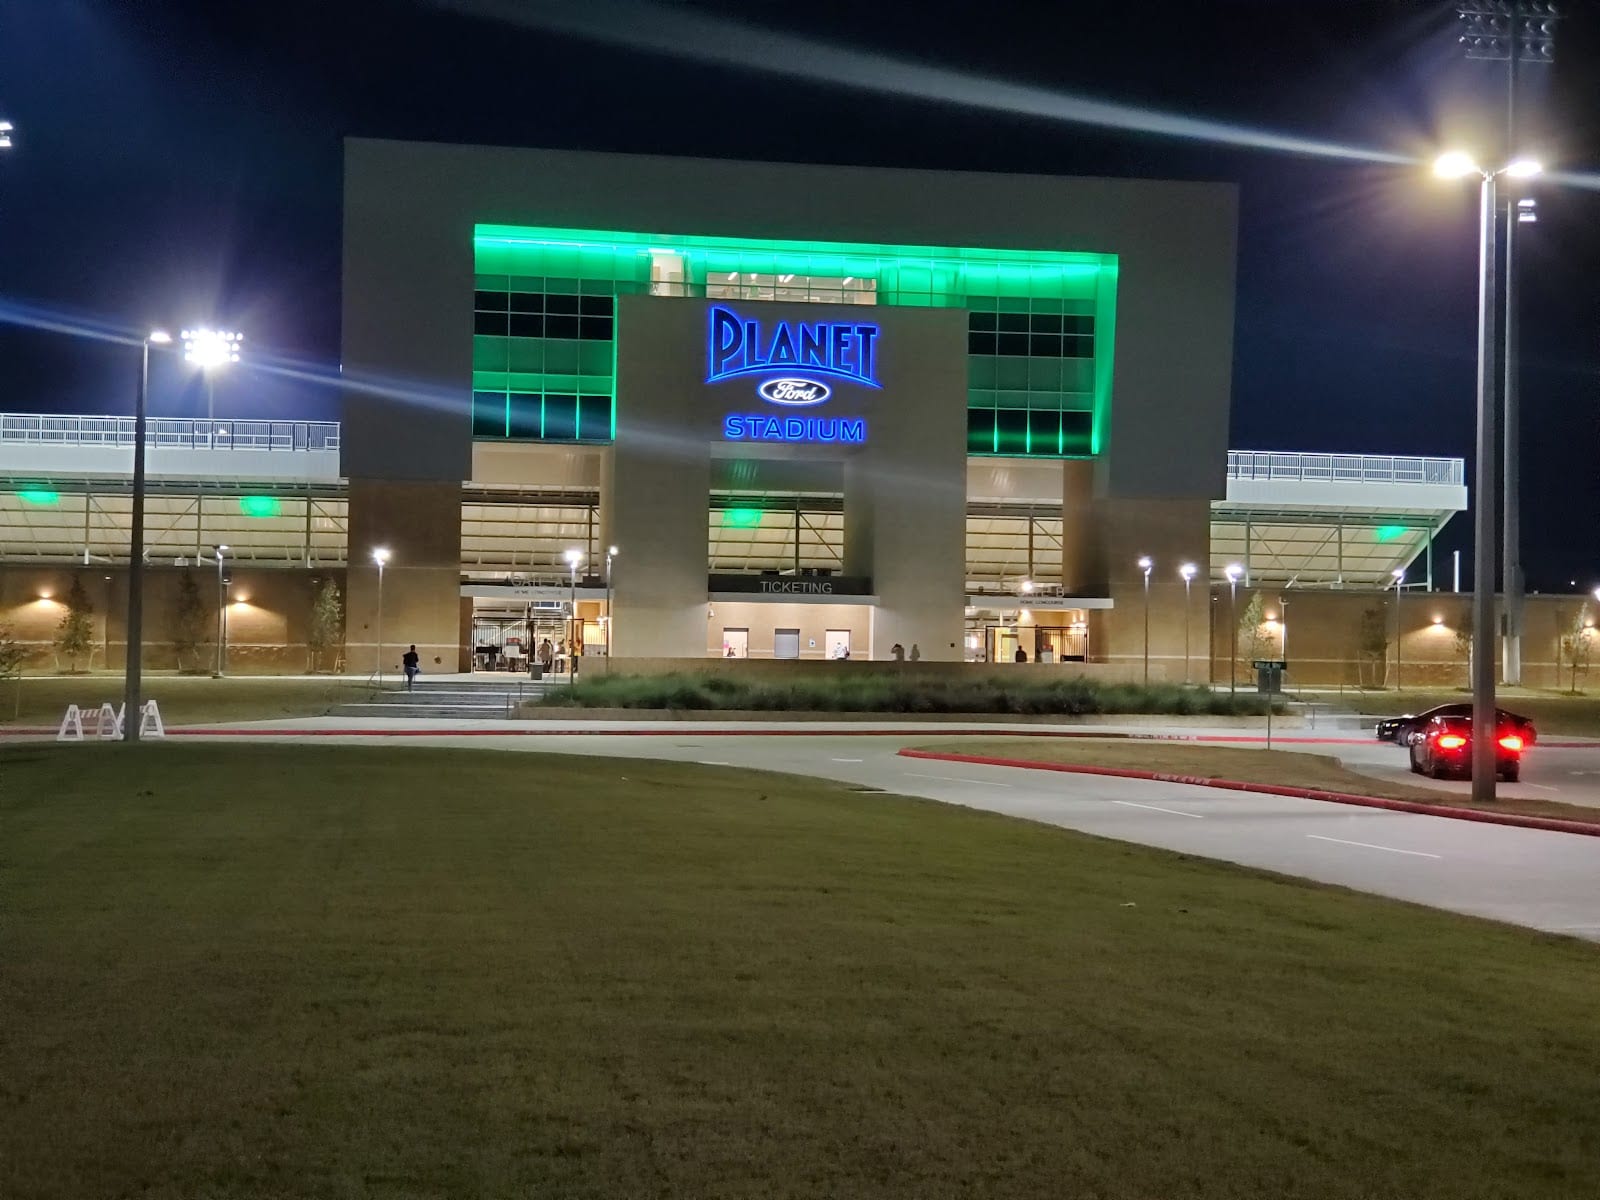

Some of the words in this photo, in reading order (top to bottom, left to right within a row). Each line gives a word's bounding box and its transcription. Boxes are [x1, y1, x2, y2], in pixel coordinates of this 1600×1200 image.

[709, 305, 878, 381] PLANET
[772, 380, 817, 401] Ford
[725, 416, 865, 442] STADIUM
[759, 581, 833, 594] TICKETING
